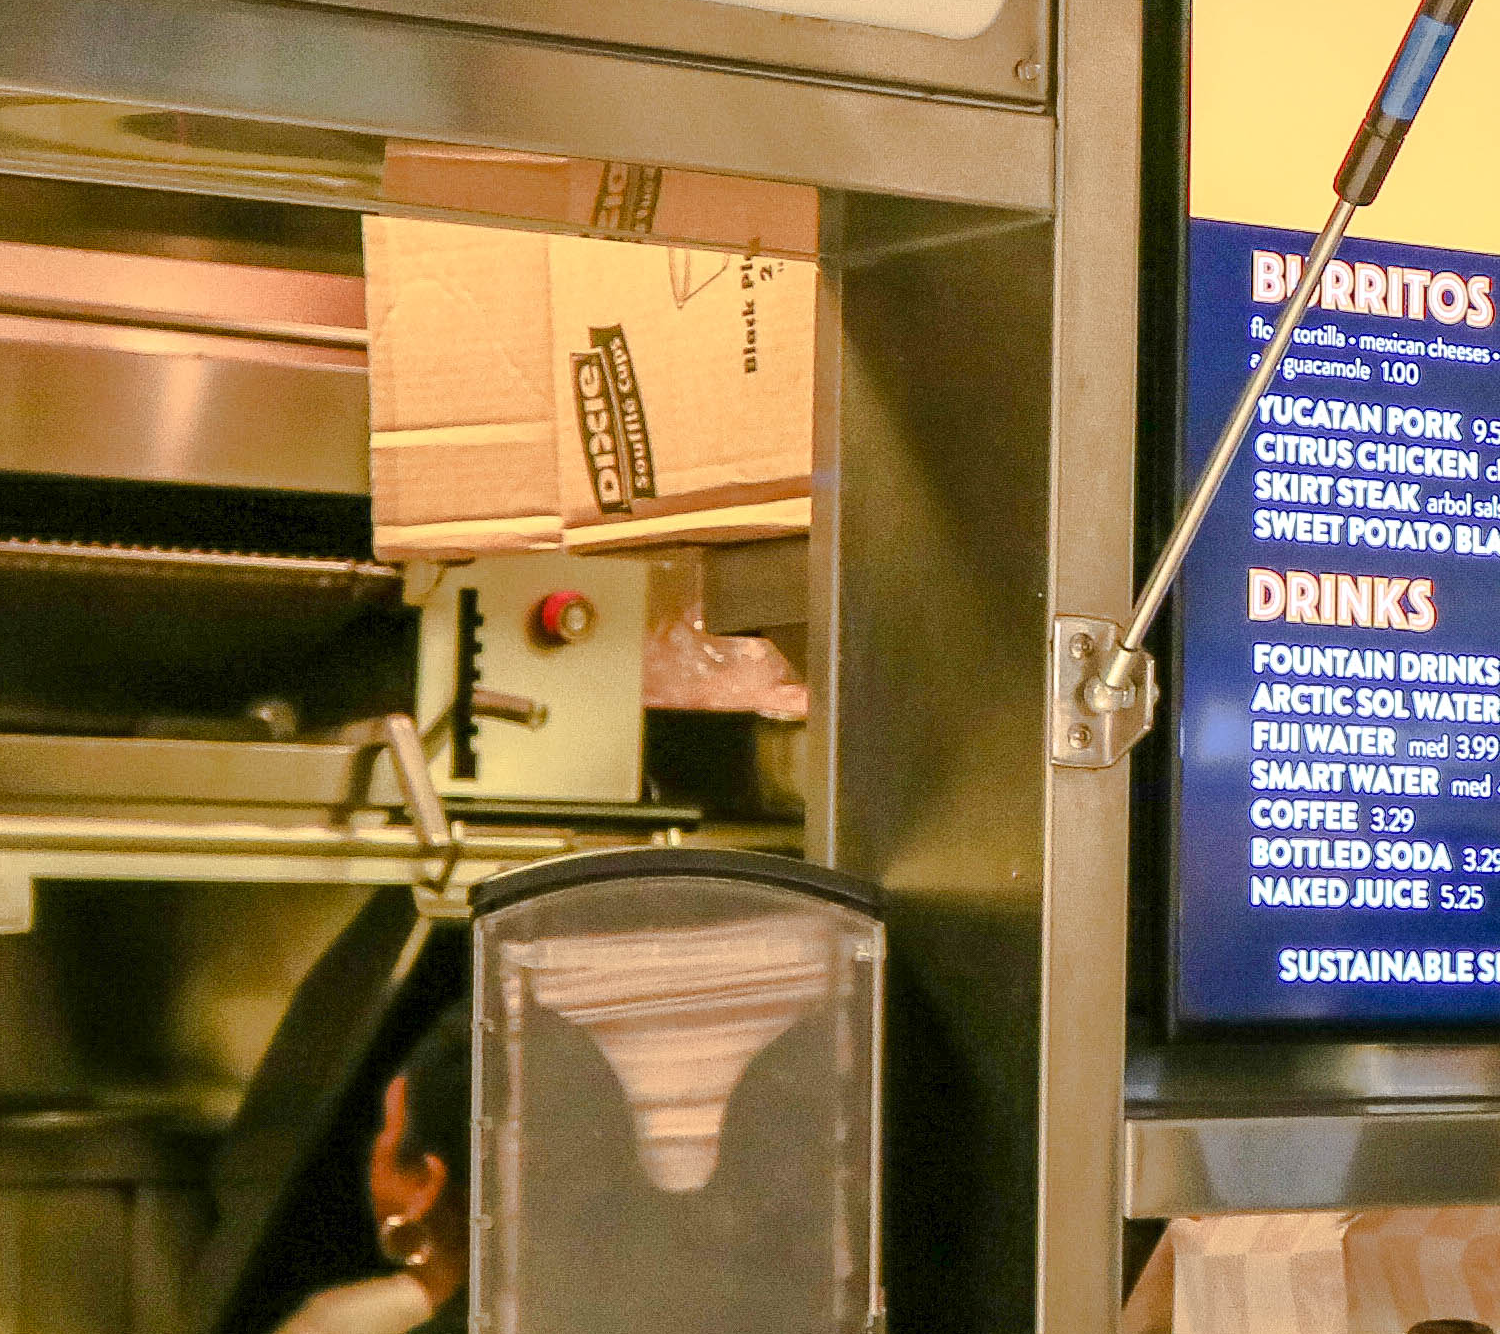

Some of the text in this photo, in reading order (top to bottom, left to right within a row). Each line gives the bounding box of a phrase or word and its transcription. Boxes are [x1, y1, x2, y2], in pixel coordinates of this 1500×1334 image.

[1292, 324, 1346, 348] tortilla
[1358, 332, 1426, 357] mexican
[1426, 336, 1491, 364] cheeses
[1280, 348, 1371, 381] guacamole
[1380, 360, 1419, 386] 1.00
[1257, 394, 1383, 434] YUCATAN
[1385, 405, 1462, 442] PORK
[1254, 432, 1355, 470] CITRUS
[1356, 440, 1479, 480] CHICKEN
[1253, 470, 1334, 506] SKIRT
[1336, 477, 1421, 513] STEAK
[1426, 490, 1472, 517] arbol
[1253, 508, 1346, 544] SWEET
[1347, 515, 1452, 552] POTATO
[1248, 567, 1435, 633] DRINKS
[1253, 643, 1396, 681] FOUNTAIN
[1250, 759, 1346, 792] SMART
[1347, 762, 1439, 796] WATER
[1450, 772, 1492, 798] med
[1250, 798, 1415, 833] COFFEE 3.29
[1250, 836, 1373, 870] BOTTLED
[1373, 840, 1453, 872] SODA
[1250, 875, 1484, 910] NAKED JUICE 5.25
[1280, 948, 1475, 982] SUSTAINABLE
